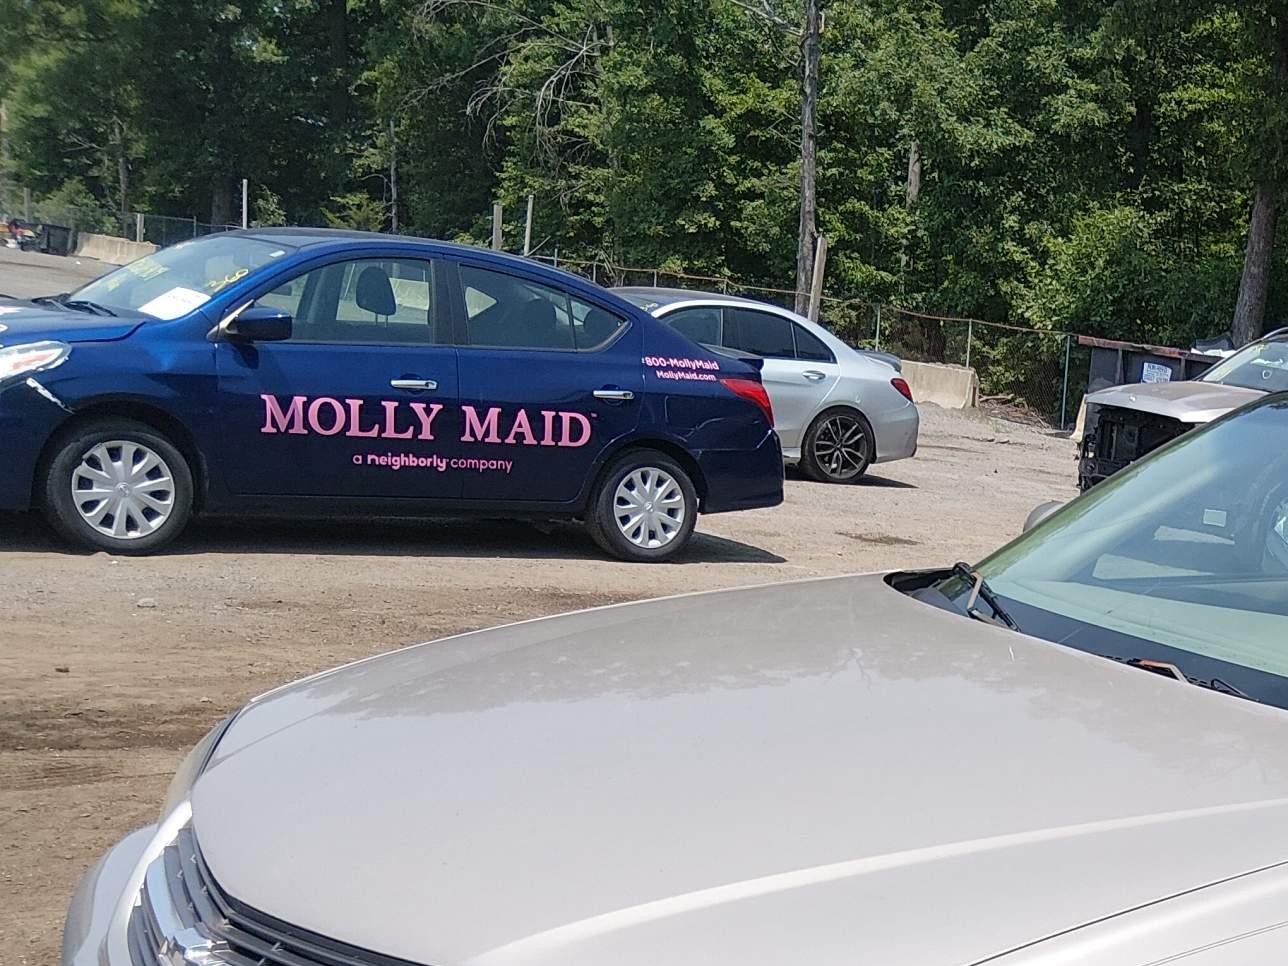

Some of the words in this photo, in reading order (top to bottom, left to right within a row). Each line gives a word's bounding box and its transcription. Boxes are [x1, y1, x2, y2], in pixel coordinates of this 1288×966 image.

[656, 370, 717, 381] MollyMaid.com
[260, 394, 444, 441] MOLLY
[460, 405, 592, 448] MAID
[352, 454, 363, 466] a
[367, 452, 446, 472] neighborly
[450, 458, 513, 474] company
